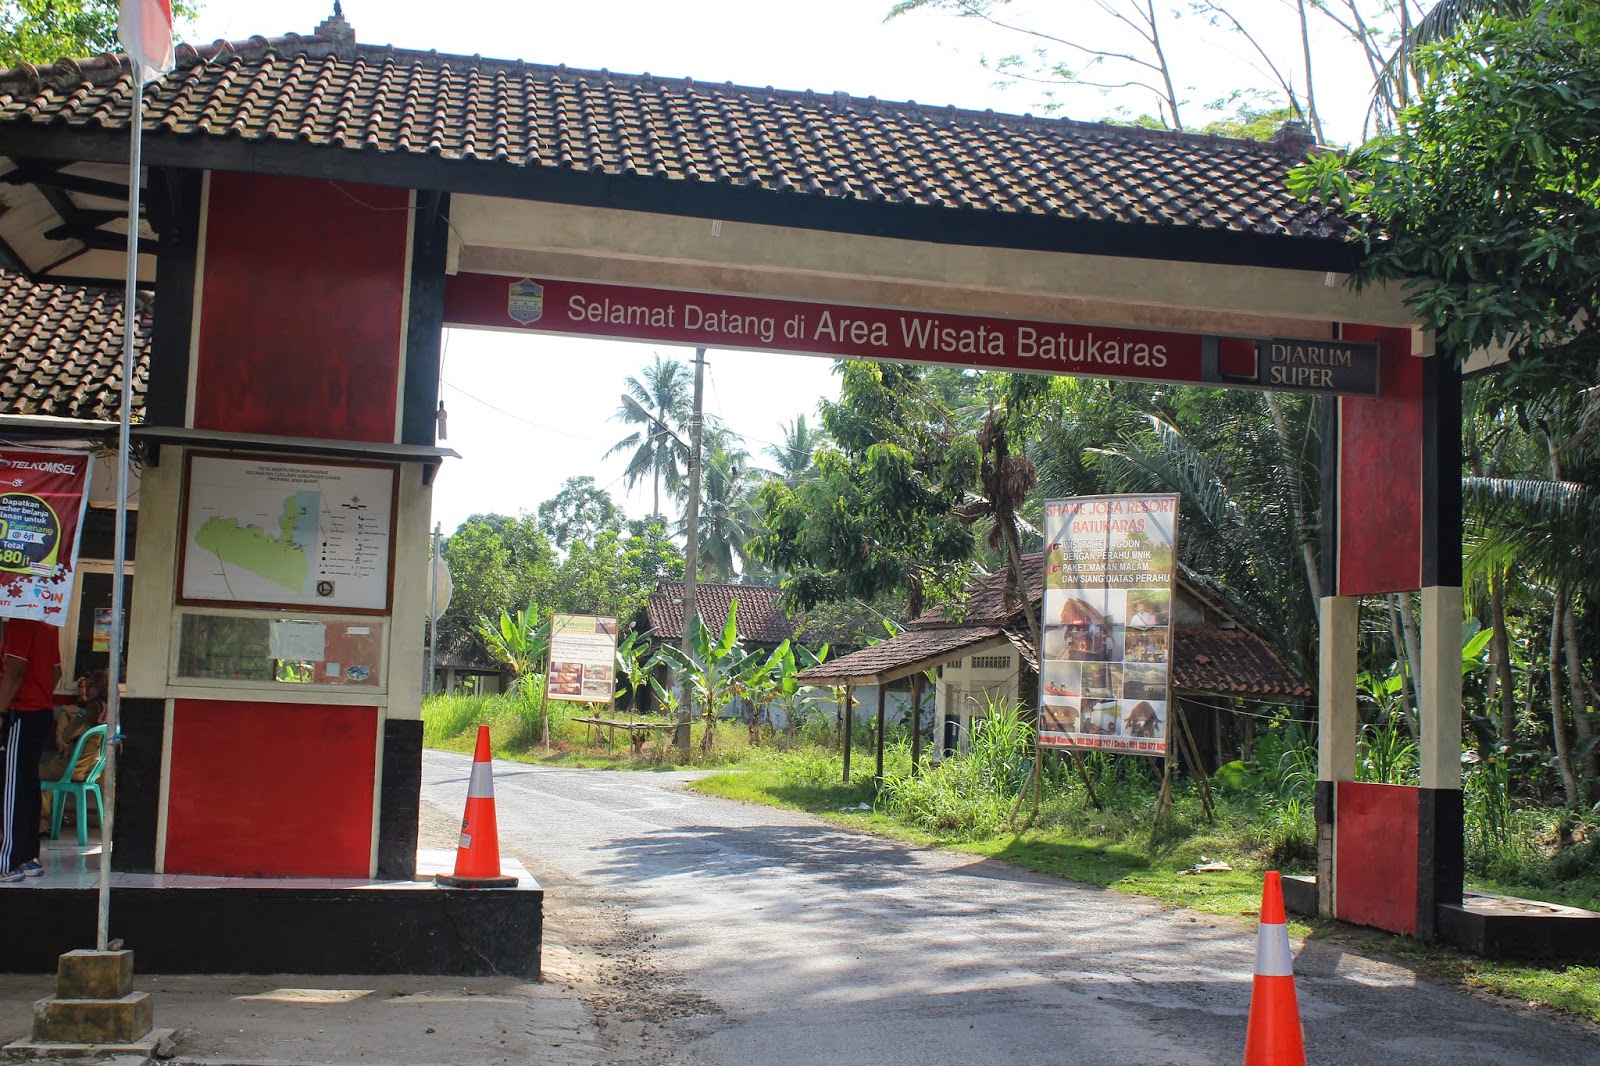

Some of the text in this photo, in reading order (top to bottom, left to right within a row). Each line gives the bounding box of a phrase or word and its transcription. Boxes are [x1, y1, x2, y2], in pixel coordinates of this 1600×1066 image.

[567, 294, 1167, 368] Selamat Datang di Area Wisata Batukaras
[1271, 344, 1352, 368] DJARUM
[1270, 365, 1335, 388] SUPER
[11, 460, 76, 476] TELKOMSEL
[2, 497, 40, 509] Dapatkan
[1046, 499, 1175, 517] SHANE JOSA RESORT
[22, 507, 49, 518] belanja
[24, 515, 47, 524] untuk
[1073, 519, 1145, 533] BATUKARAS
[9, 521, 54, 536] Pemenang
[3, 541, 24, 550] Total
[1063, 550, 1151, 561] DENGAN PERAHU UNIK
[1063, 564, 1088, 572] PAKET
[1089, 563, 1119, 571] MAKAN
[1062, 574, 1170, 583] DAN SIANG DIATAS PERAHU
